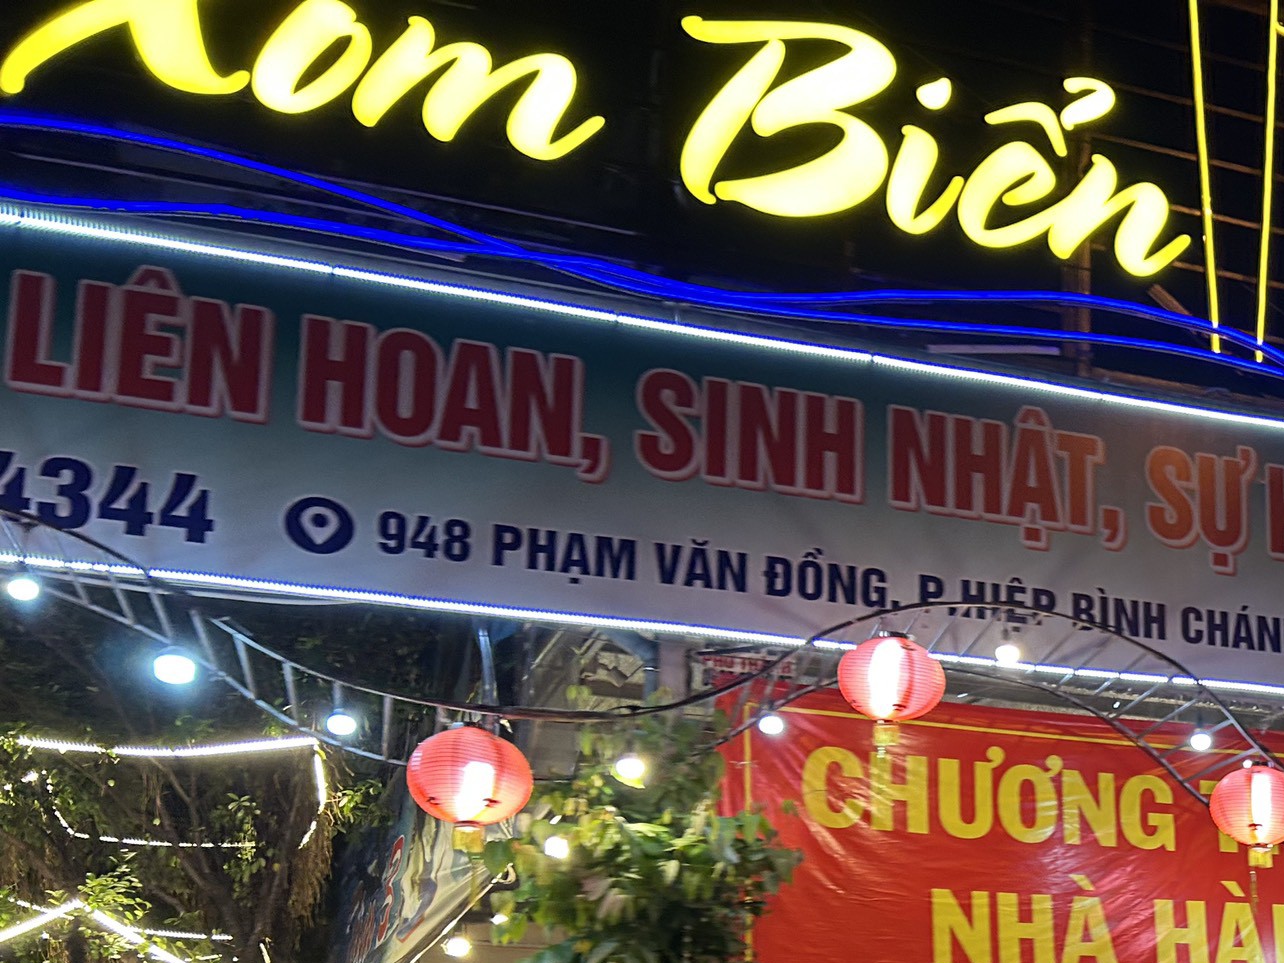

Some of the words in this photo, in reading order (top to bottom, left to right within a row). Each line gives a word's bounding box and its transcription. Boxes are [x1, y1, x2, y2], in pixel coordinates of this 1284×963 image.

[681, 15, 1191, 277] Biển
[5, 265, 274, 424] LIÊN
[297, 314, 610, 482] HOAN,
[635, 369, 865, 503] SINH
[887, 405, 1128, 553] NHẬT,
[1146, 446, 1255, 576] SỰ
[378, 510, 473, 563] 948
[491, 523, 638, 585] PHẠM
[654, 538, 748, 593] VĂN
[1071, 587, 1167, 641] BÌNH
[802, 746, 1177, 852] CHƯƠNG
